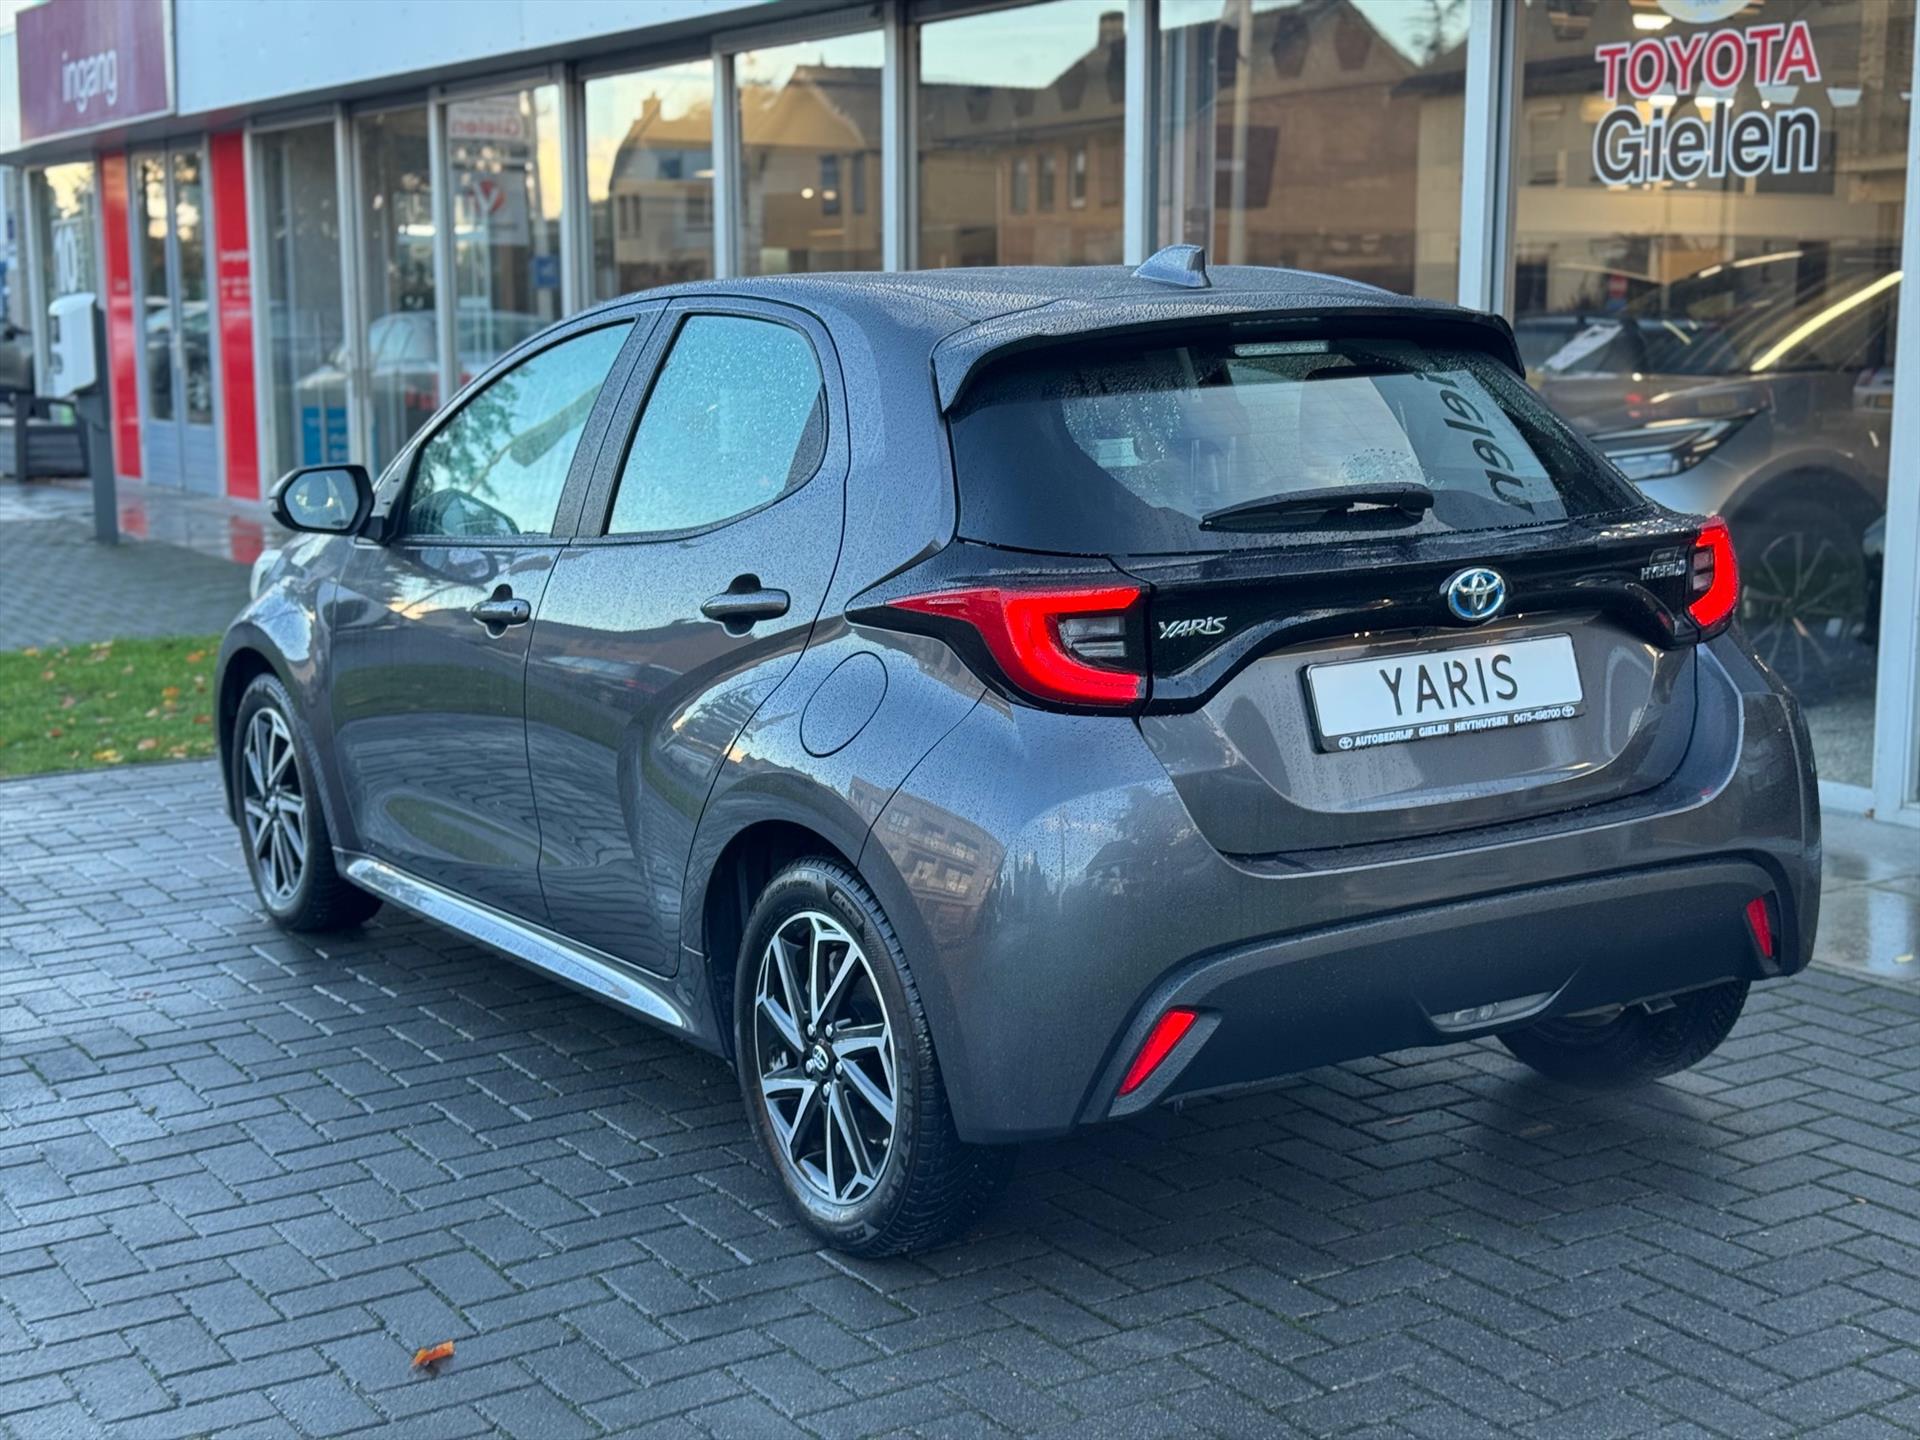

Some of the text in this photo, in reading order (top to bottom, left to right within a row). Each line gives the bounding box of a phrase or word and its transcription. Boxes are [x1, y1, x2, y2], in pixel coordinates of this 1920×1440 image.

[62, 49, 116, 112] ingang
[1596, 21, 1821, 100] TOYOTA
[1593, 101, 1820, 184] Gielen
[1159, 616, 1228, 639] YARIS
[1379, 654, 1518, 715] YARIS
[1355, 728, 1413, 747] AUTOBEDRIJF
[1419, 723, 1449, 737] GIELEN
[1454, 715, 1508, 732] HEYTHUYSEN
